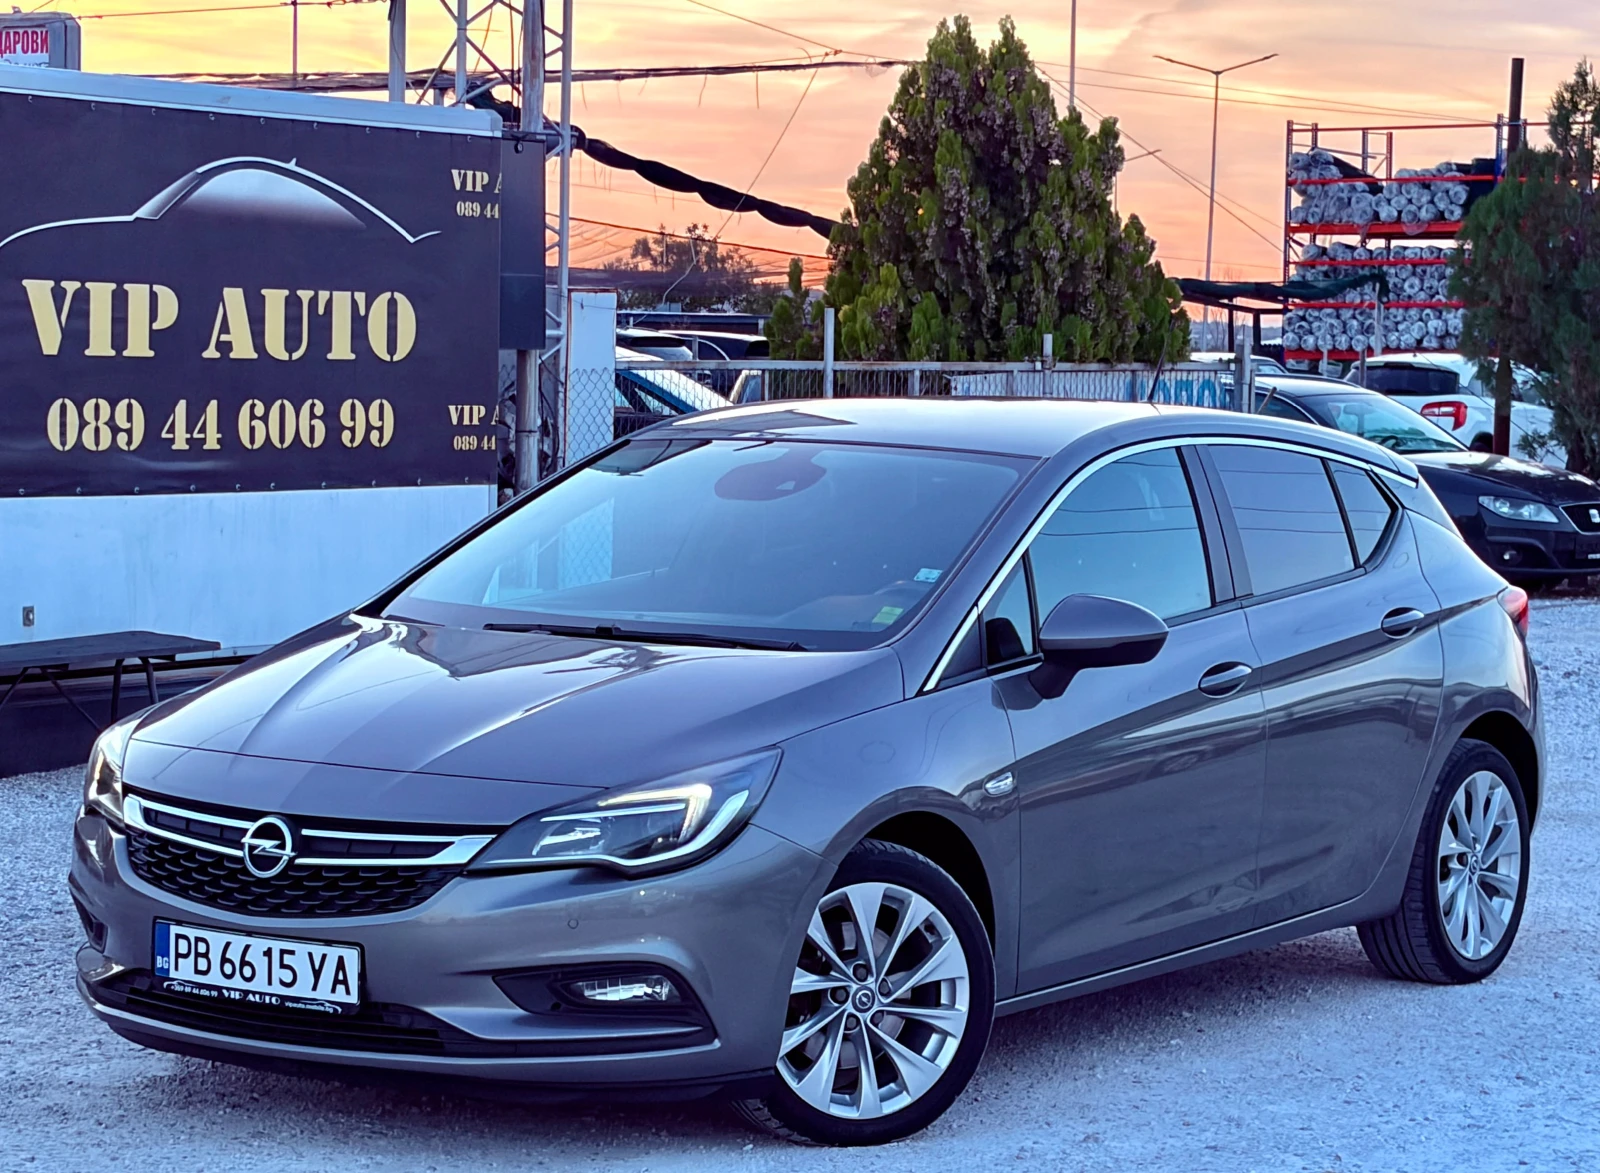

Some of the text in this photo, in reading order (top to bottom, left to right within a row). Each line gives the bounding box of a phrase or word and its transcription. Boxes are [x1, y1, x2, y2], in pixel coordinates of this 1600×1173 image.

[450, 168, 490, 193] VIP
[456, 200, 499, 219] 089 44
[22, 278, 417, 362] VIP AUTO
[47, 397, 395, 452] 089 44 606 99
[447, 404, 486, 426] VIP
[453, 434, 496, 451] 089 44
[156, 955, 170, 969] BG
[174, 933, 352, 996] PB 6615 YA
[222, 989, 281, 1005] VIP AUTO
